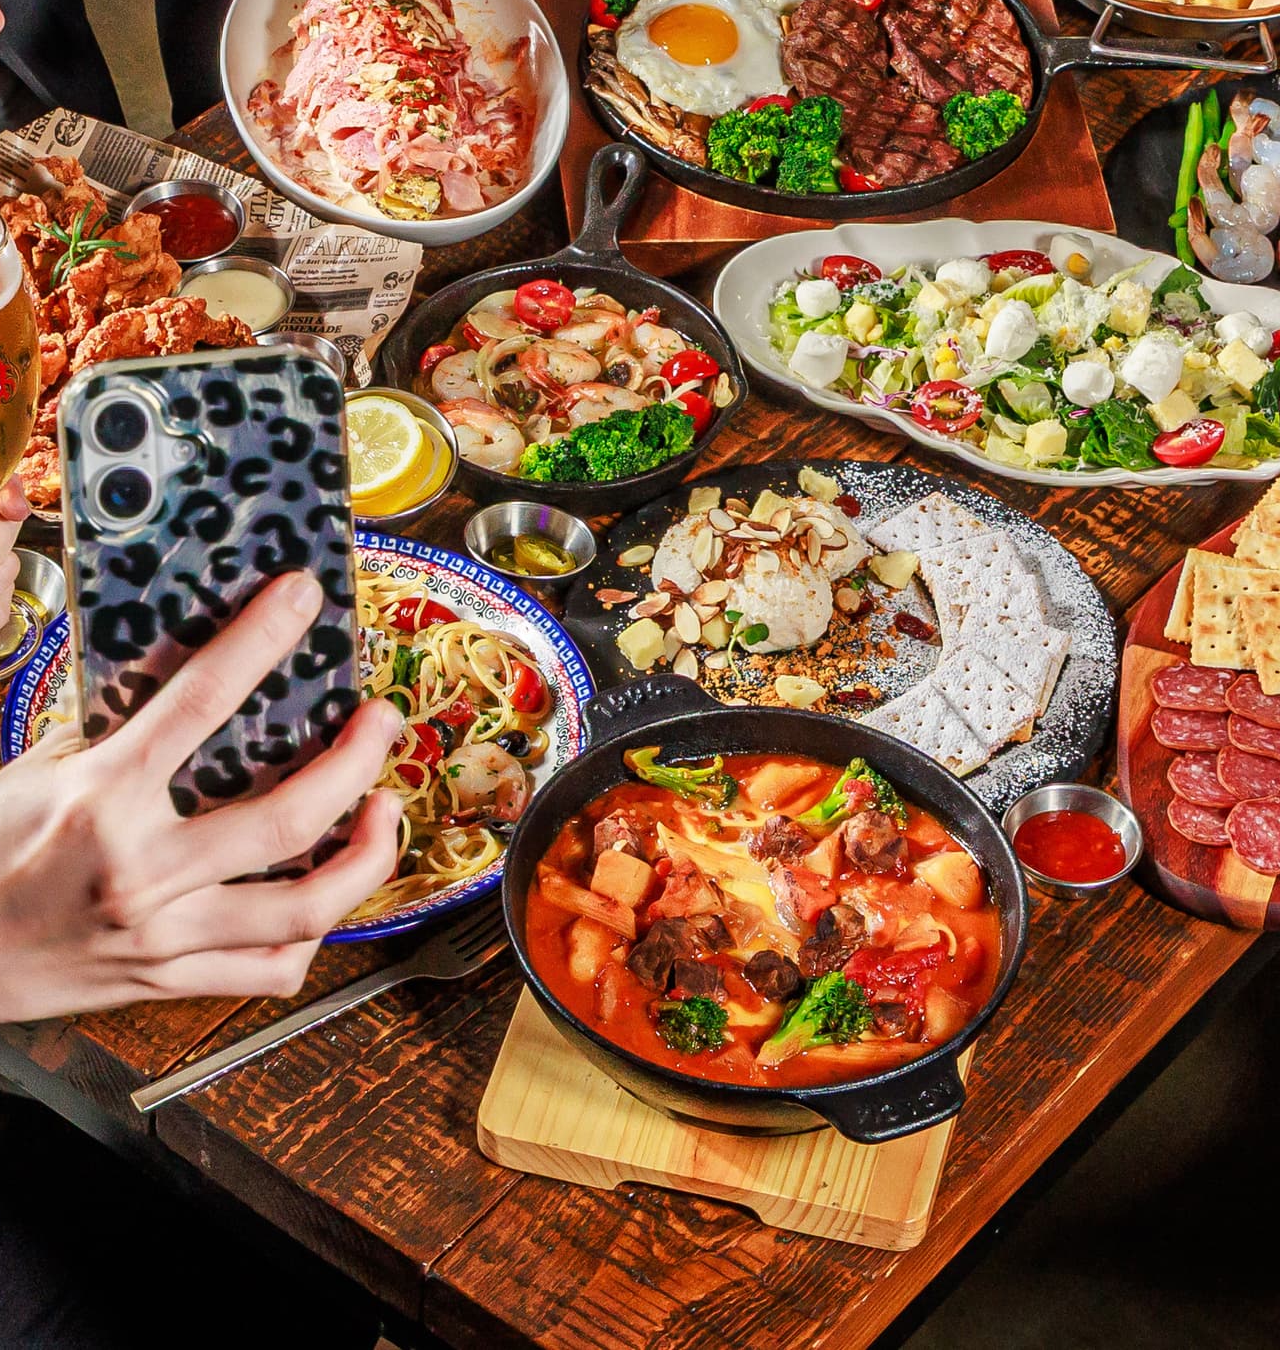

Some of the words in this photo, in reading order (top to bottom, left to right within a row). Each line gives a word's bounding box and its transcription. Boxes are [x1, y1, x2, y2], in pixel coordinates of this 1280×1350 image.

[249, 191, 268, 225] YLE
[296, 234, 401, 257] BAKERY
[280, 315, 316, 324] RESH
[280, 324, 343, 334] OMEMADE
